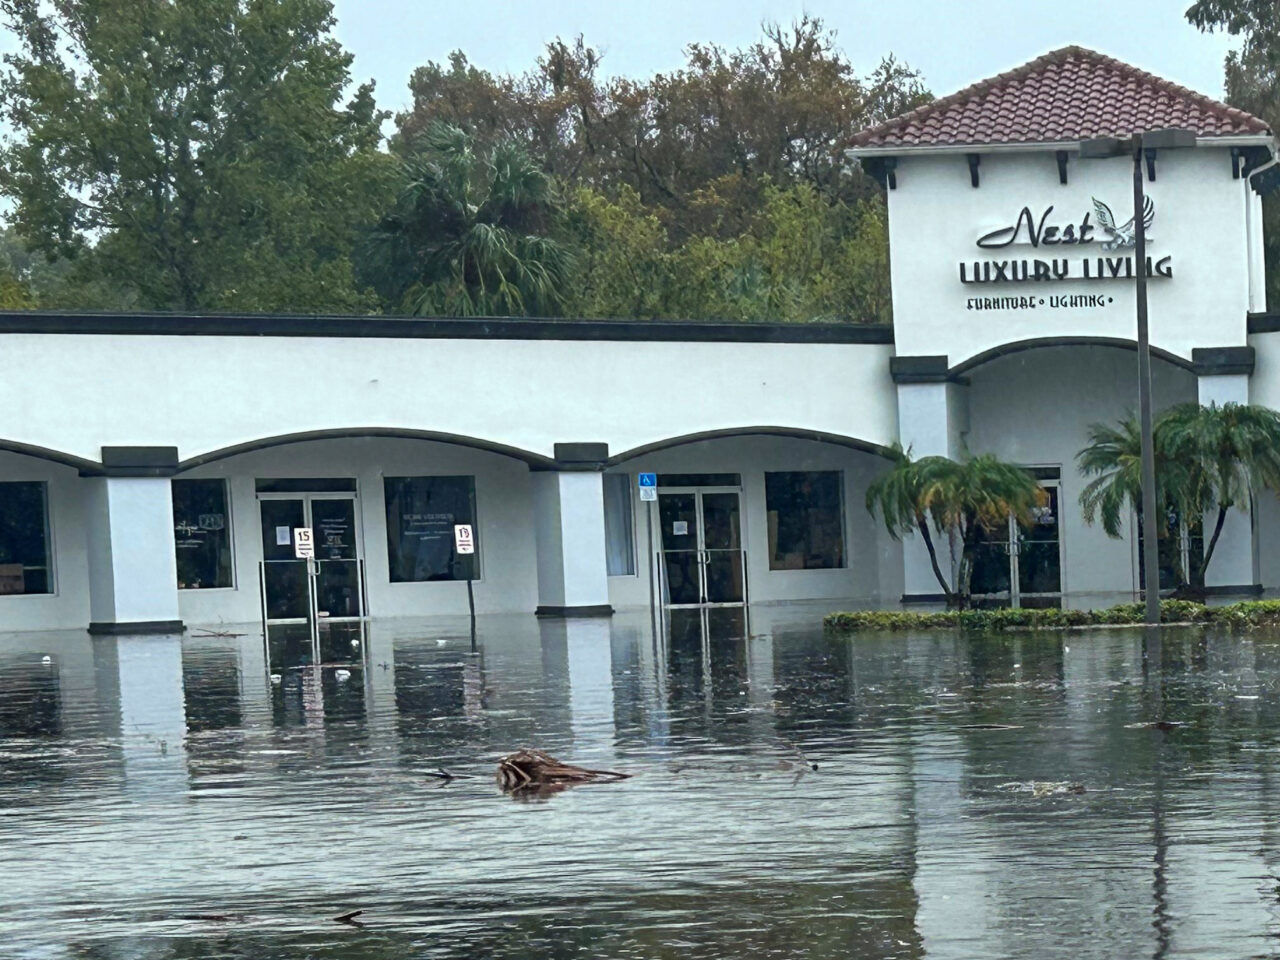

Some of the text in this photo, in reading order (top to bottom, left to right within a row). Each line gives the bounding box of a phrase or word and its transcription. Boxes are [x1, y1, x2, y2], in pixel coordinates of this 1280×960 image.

[976, 206, 1094, 247] Nest
[959, 259, 1068, 283] LUXURY
[967, 295, 1105, 310] FURNITURE LIGHTING
[298, 530, 310, 541] 15
